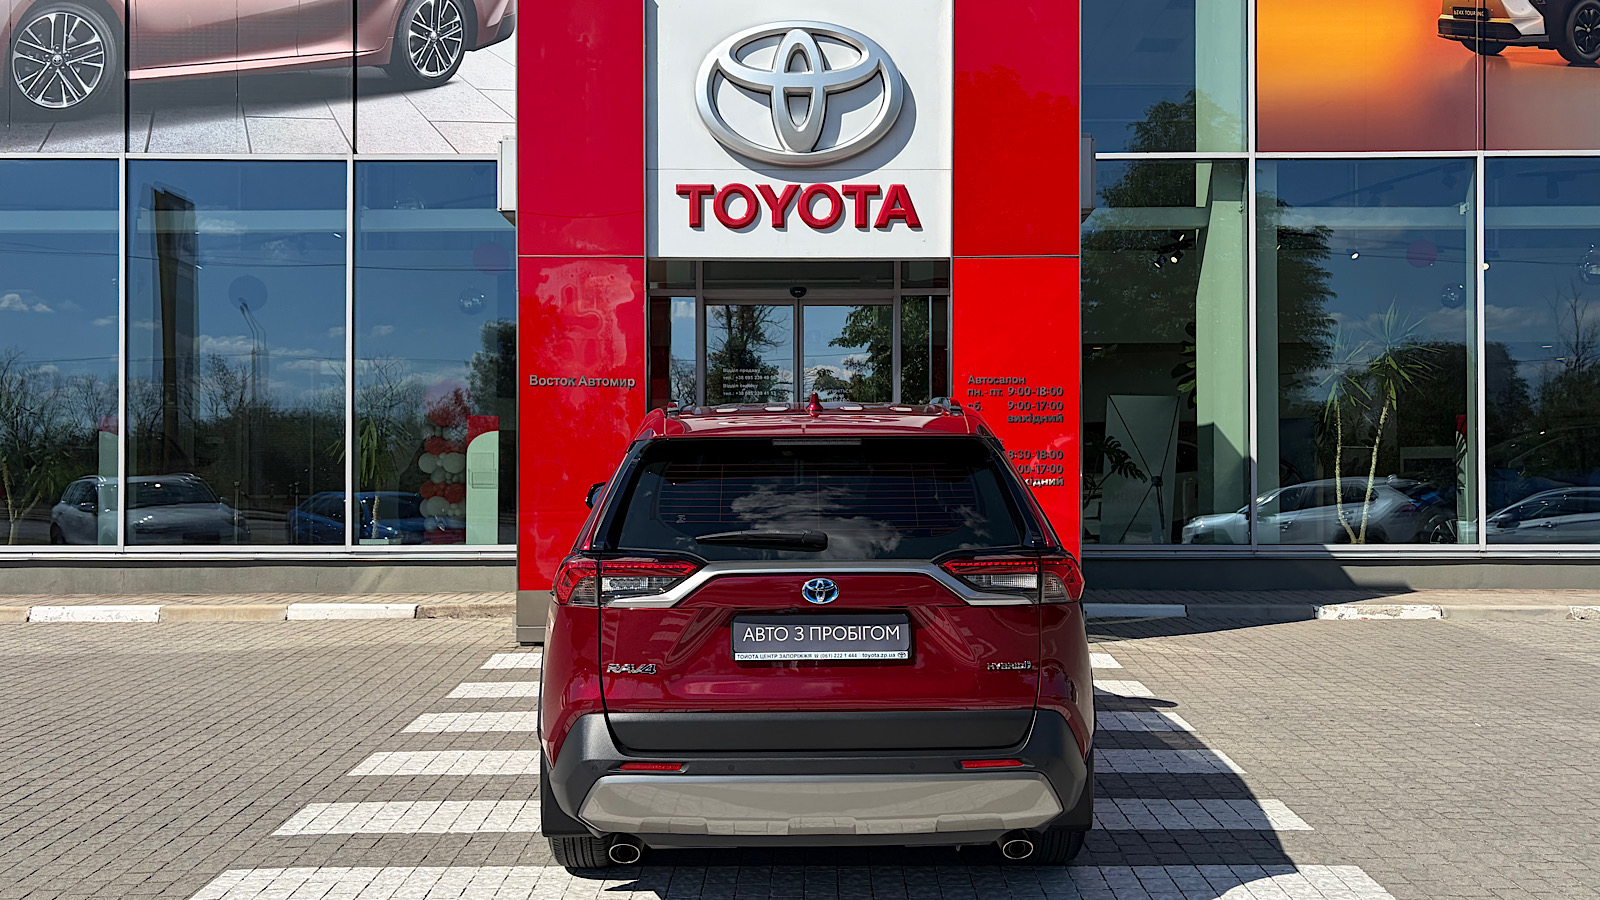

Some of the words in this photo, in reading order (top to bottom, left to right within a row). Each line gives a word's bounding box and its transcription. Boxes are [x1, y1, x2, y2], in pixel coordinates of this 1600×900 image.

[676, 183, 923, 230] TOYOTA
[529, 374, 577, 387] Восток
[578, 375, 636, 390] Автомир
[967, 375, 1026, 385] Автосалон
[967, 388, 984, 397] пн.
[990, 388, 1004, 397] пт.
[1007, 386, 1064, 397] 9:00-18:00
[1007, 400, 1064, 411] 9:00-17:00
[1007, 413, 1064, 424] вихідний
[742, 626, 789, 642] АВТО
[809, 625, 900, 641] ПРОБІГОМ
[606, 663, 657, 675] RAV4
